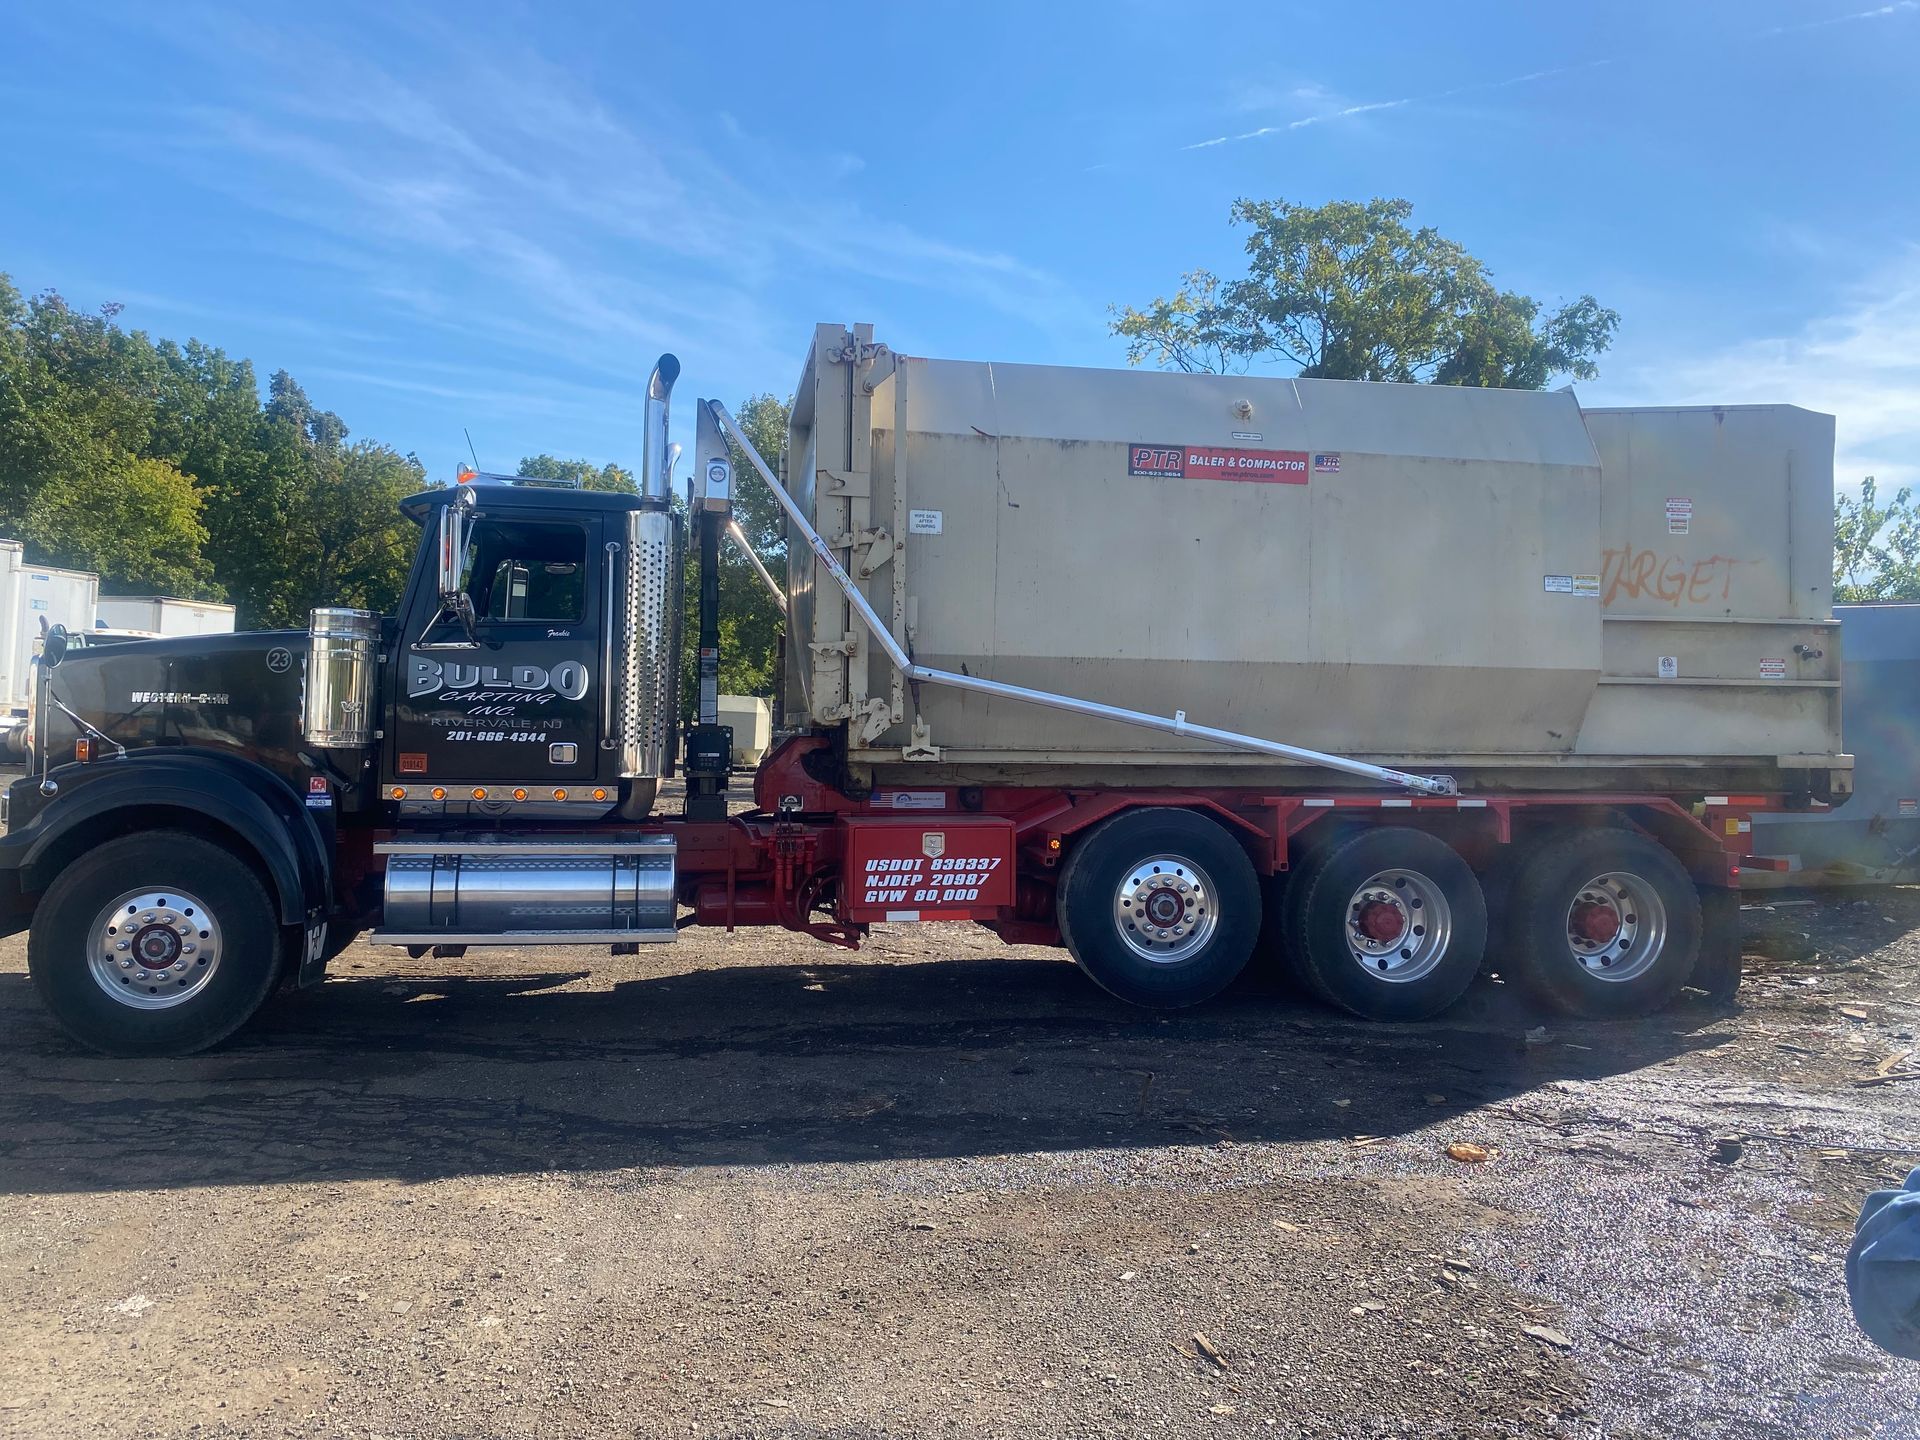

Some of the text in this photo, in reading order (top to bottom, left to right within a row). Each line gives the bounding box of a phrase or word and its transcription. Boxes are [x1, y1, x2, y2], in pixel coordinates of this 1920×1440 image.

[1133, 448, 1182, 470] PTR
[1189, 454, 1306, 471] BALER & COMPACTOR
[1601, 543, 1760, 608] TARGET
[547, 629, 571, 638] Frankie
[270, 652, 289, 667] 23
[407, 654, 589, 701] BULDO
[131, 691, 191, 704] WESTERN
[438, 691, 557, 705] CARTING
[466, 705, 515, 716] INC.
[431, 718, 563, 730] RIVERVALE, NJ
[446, 731, 547, 743] 201-666-4344
[865, 857, 1002, 872] USDOT 838337
[865, 873, 990, 888] NJDEP 20987
[864, 888, 979, 904] GVW 80,000
